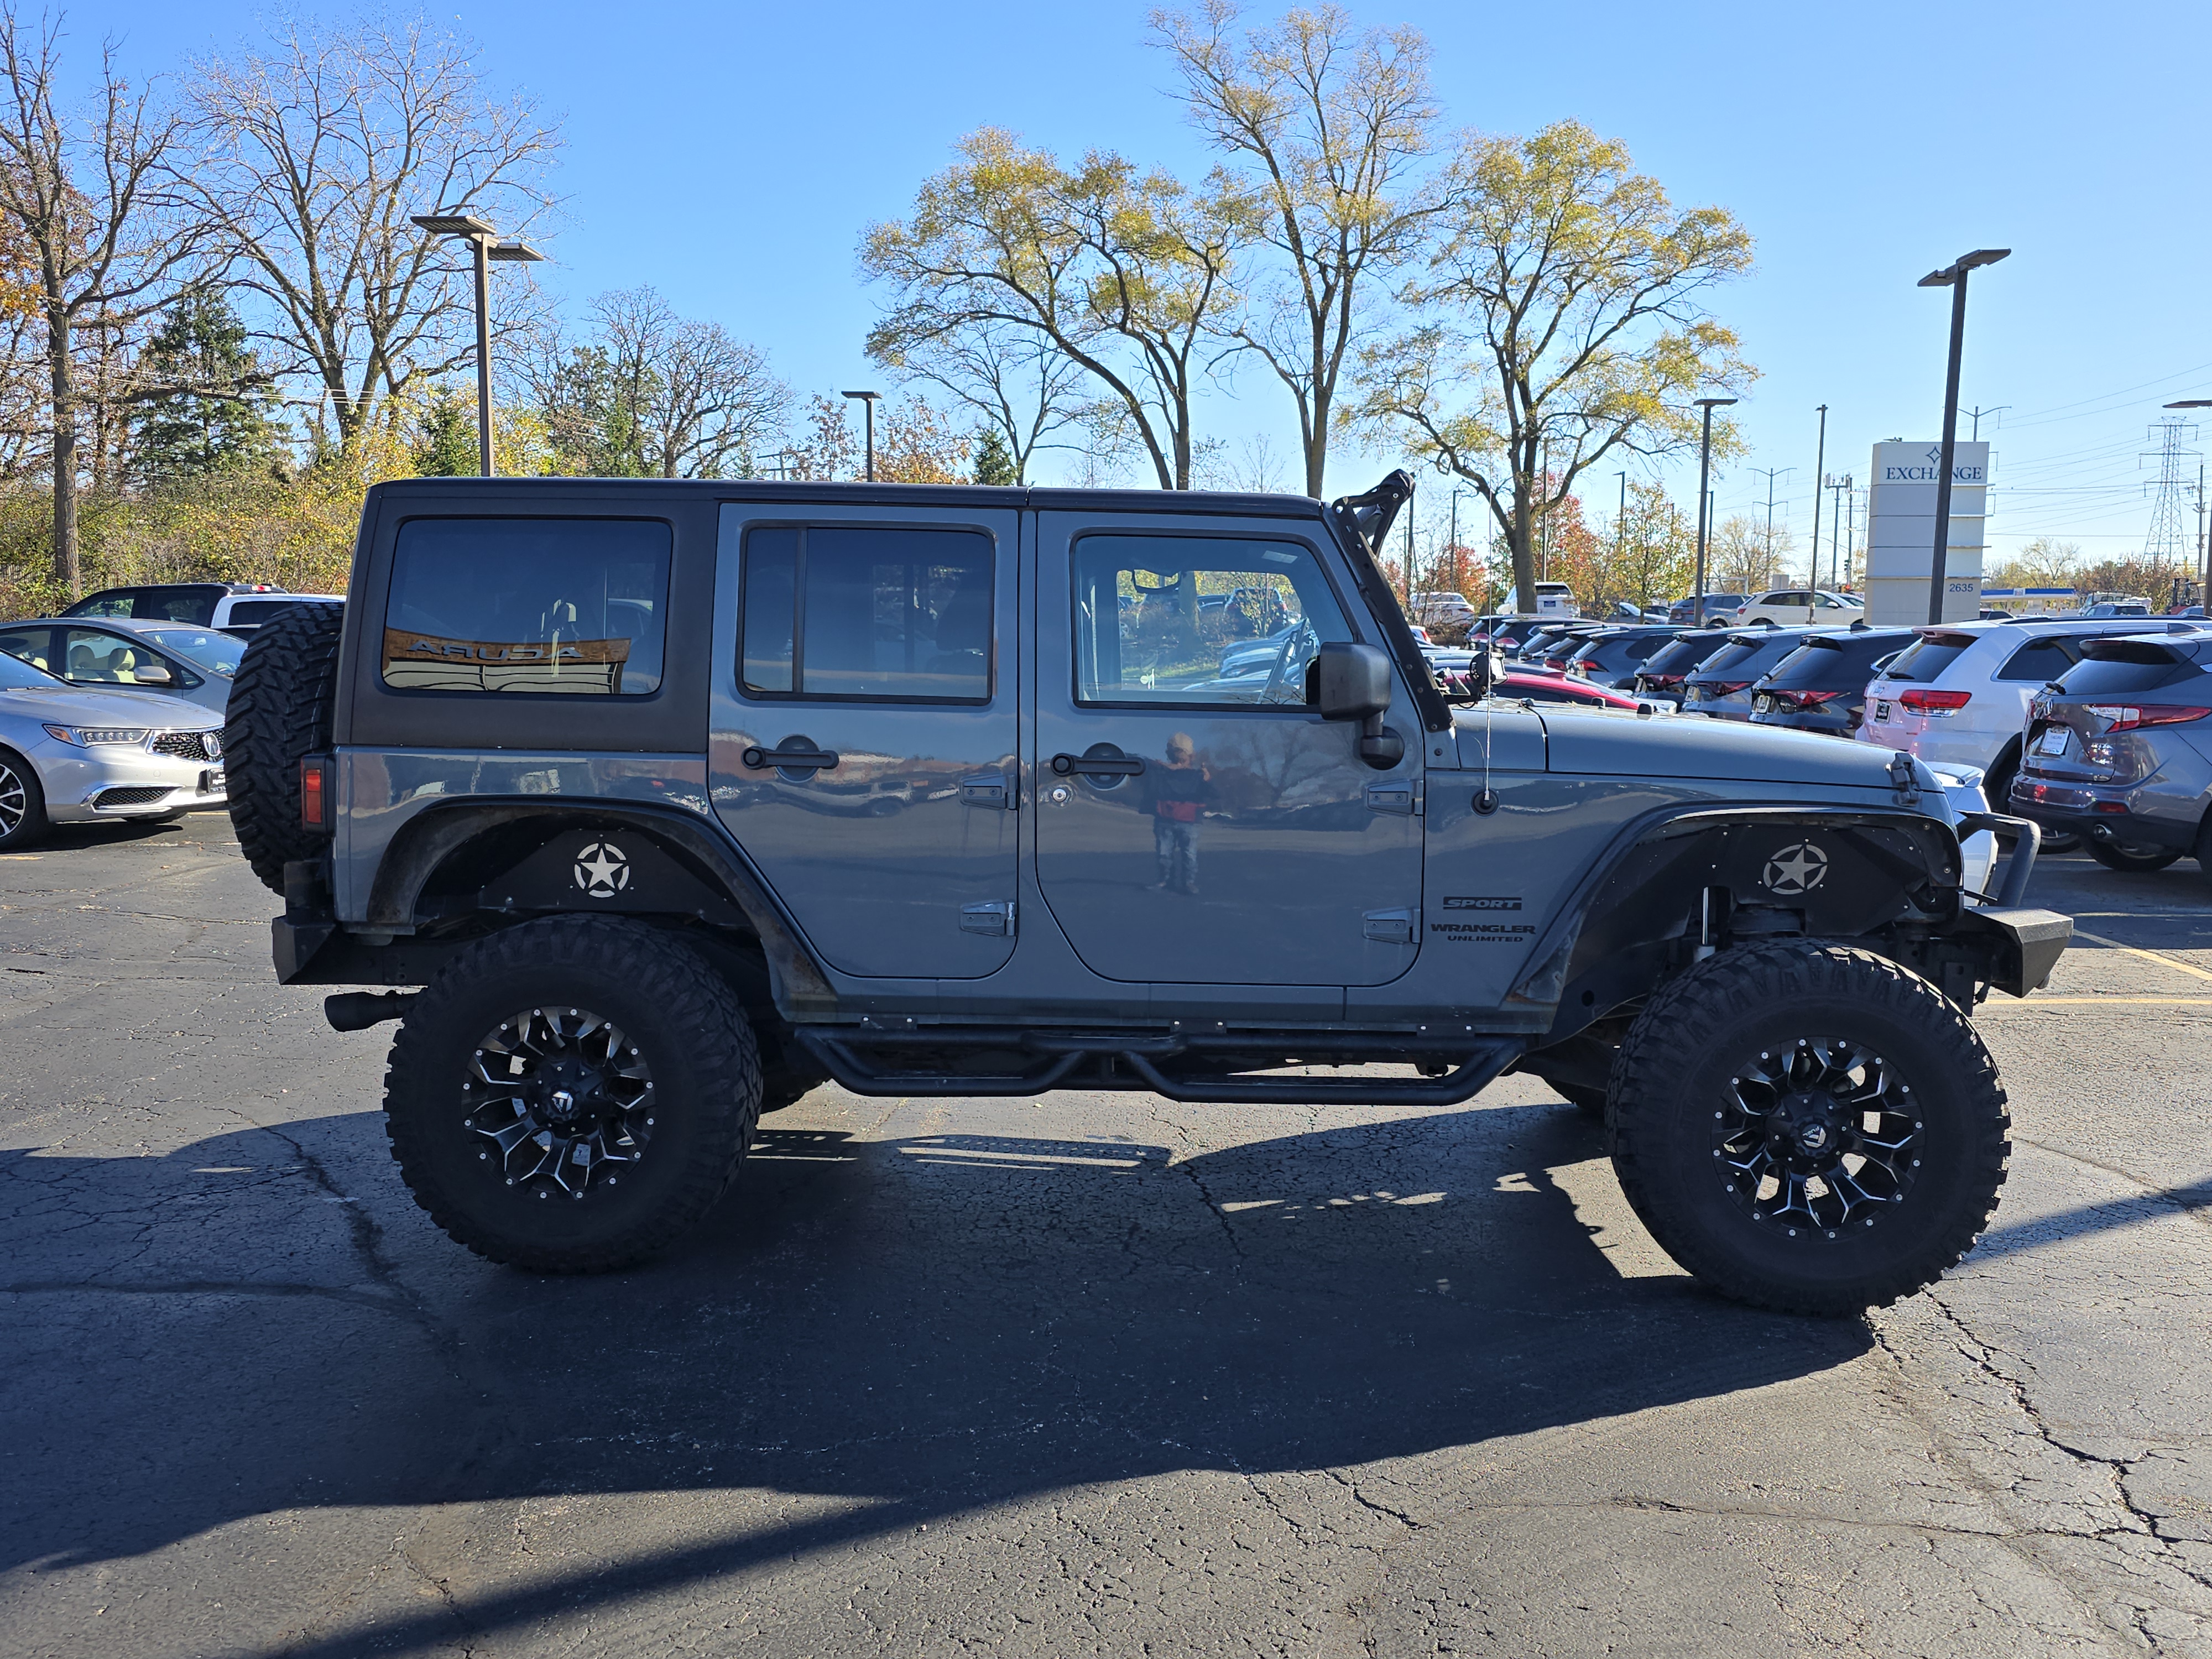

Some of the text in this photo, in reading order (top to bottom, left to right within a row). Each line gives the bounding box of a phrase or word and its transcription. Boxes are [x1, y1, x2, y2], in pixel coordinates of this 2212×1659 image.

[1949, 583, 1974, 593] 2635
[1443, 899, 1522, 909] SPORT
[1431, 924, 1536, 935] WRANGLER
